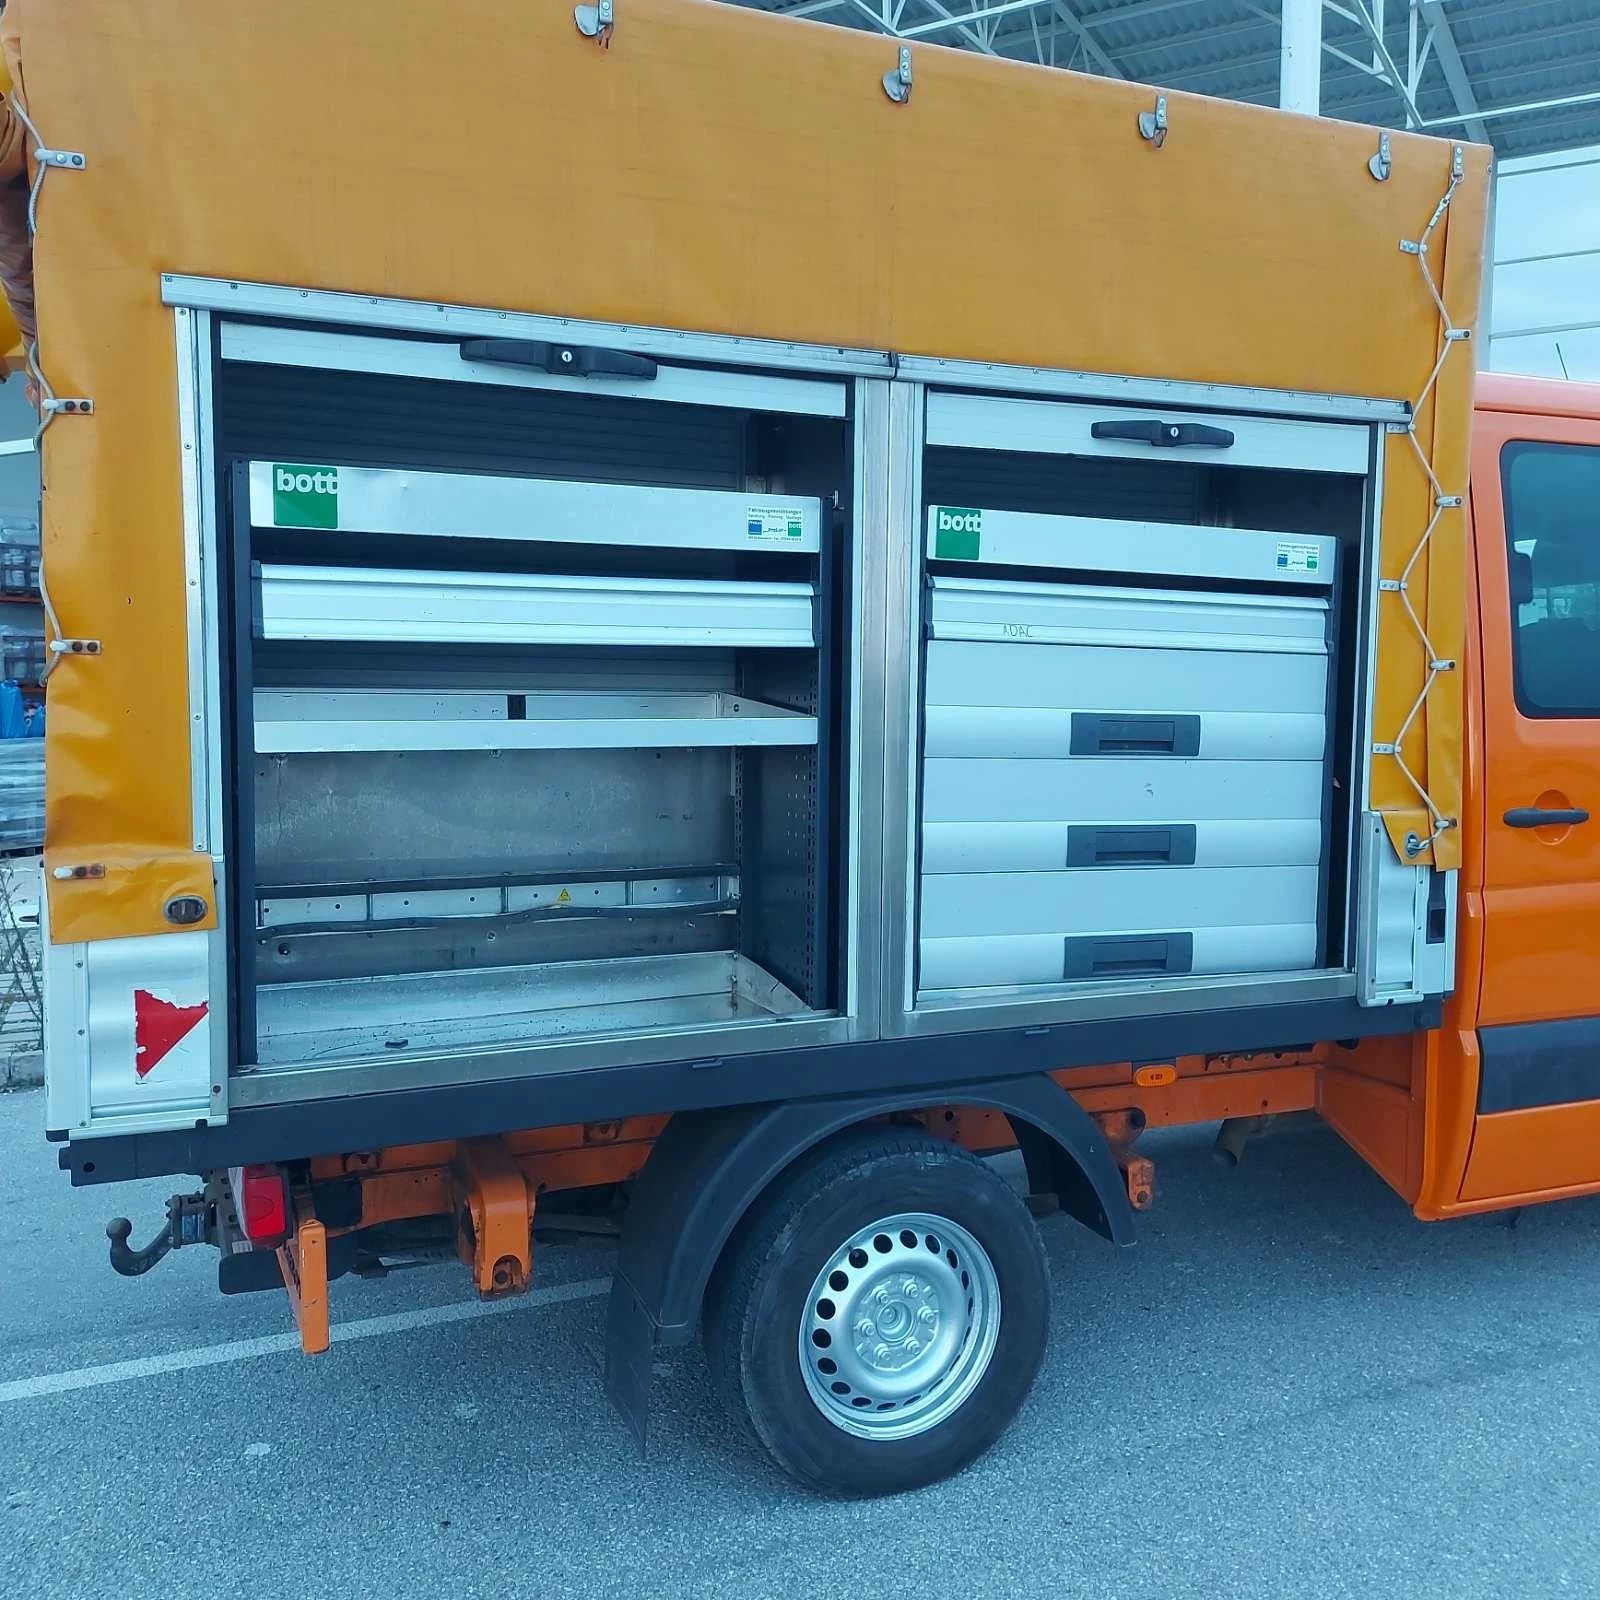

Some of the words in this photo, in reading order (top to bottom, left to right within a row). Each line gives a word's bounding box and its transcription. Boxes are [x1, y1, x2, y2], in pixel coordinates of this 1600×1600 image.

[277, 468, 337, 494] bott
[939, 511, 981, 532] bott
[1003, 624, 1033, 638] ADAC
